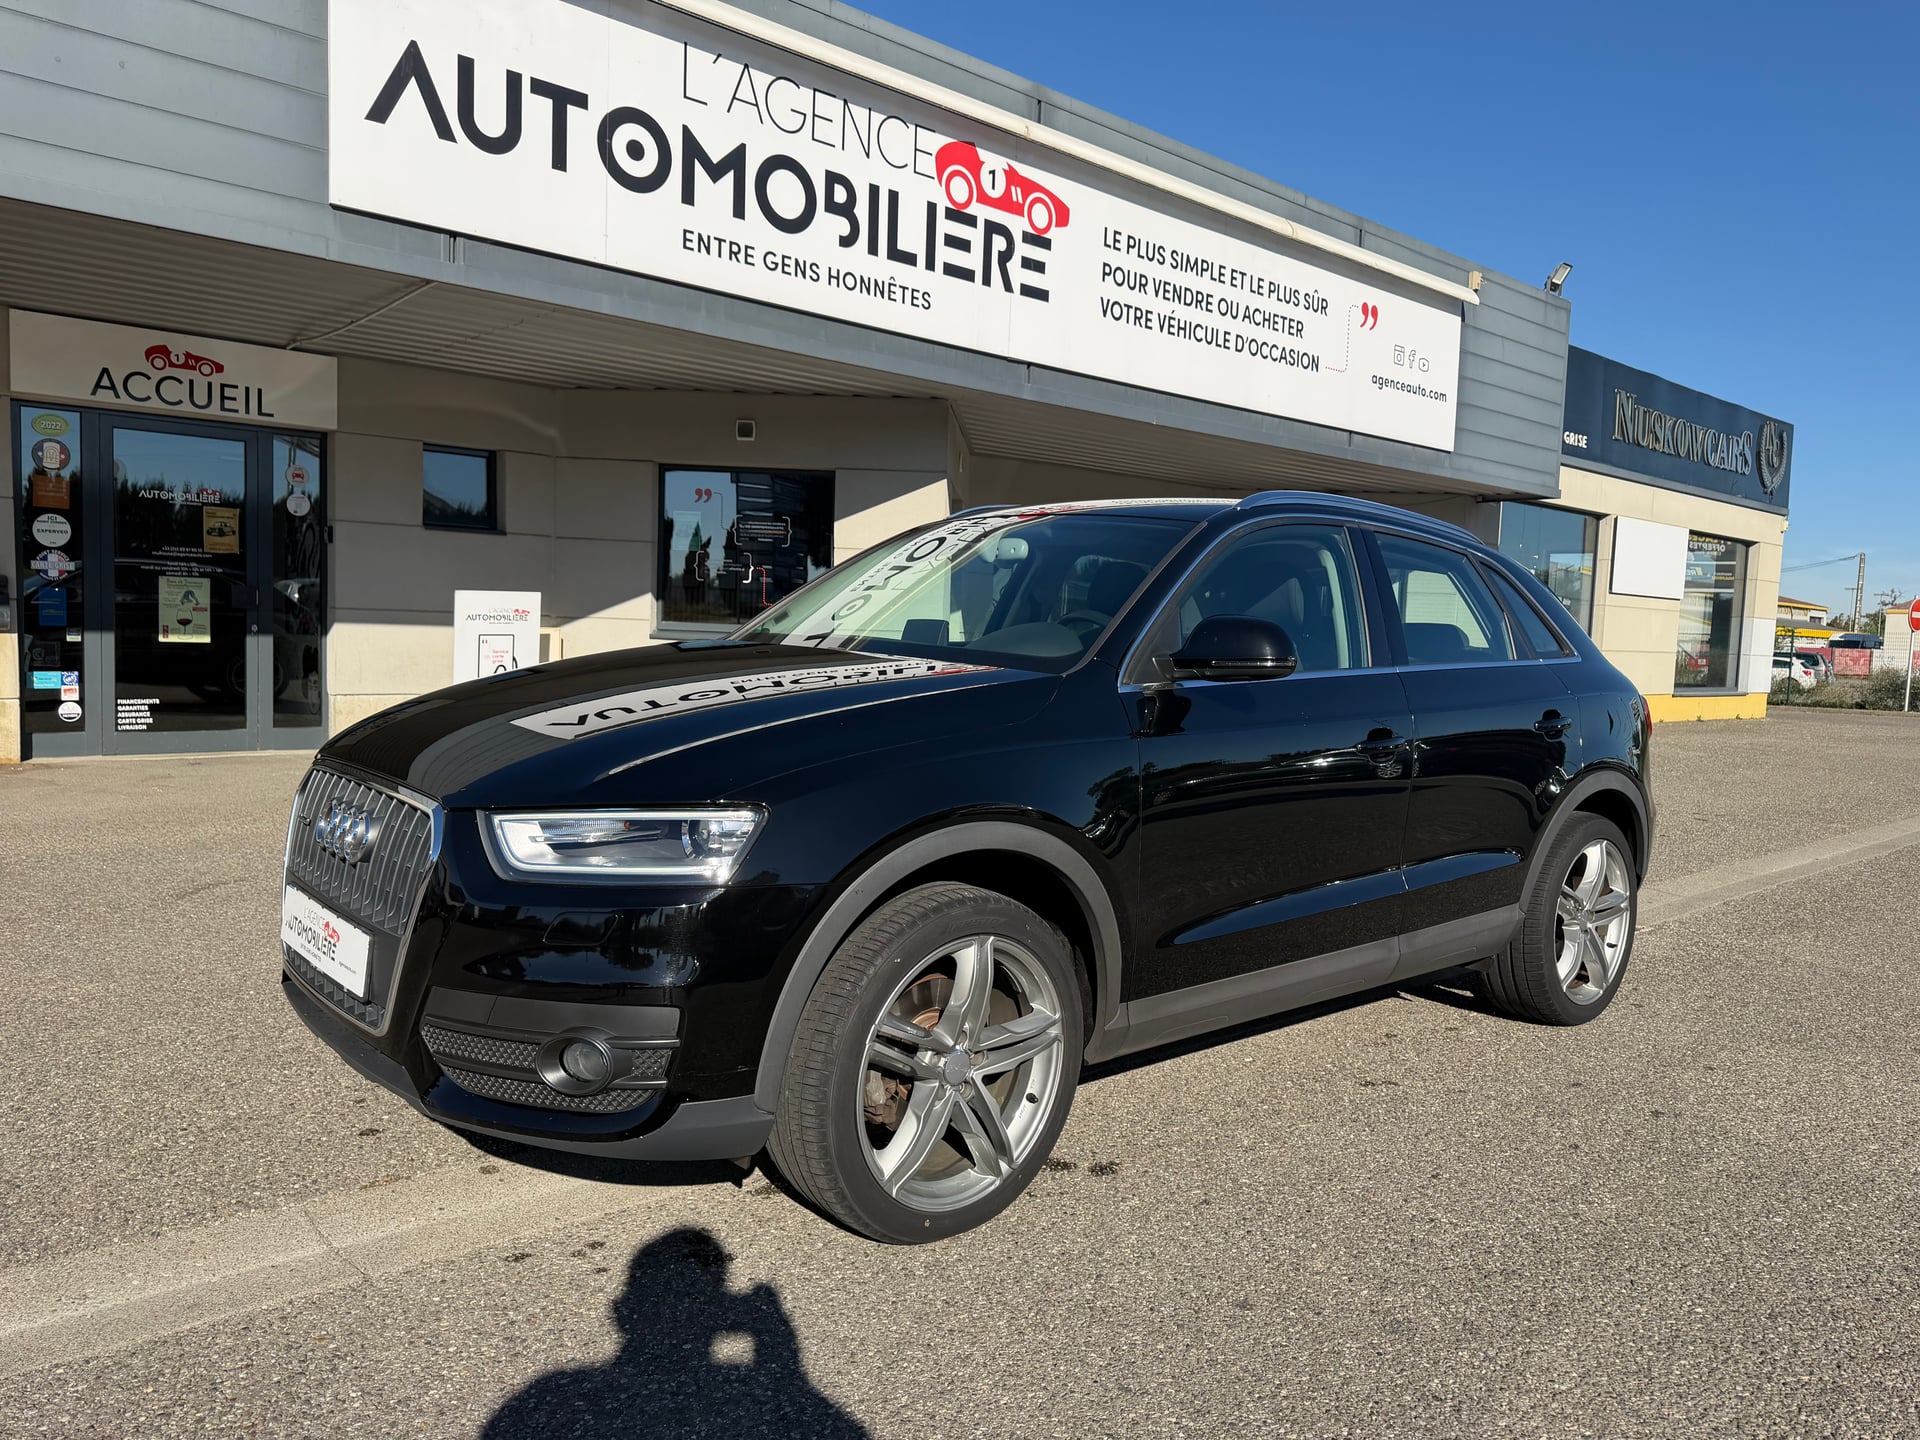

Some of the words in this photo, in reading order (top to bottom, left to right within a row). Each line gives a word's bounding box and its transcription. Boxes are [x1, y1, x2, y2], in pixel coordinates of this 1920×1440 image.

[987, 168, 997, 191] 1
[682, 228, 756, 267] ENTRE
[763, 251, 821, 283] GENS
[828, 266, 932, 310] HONNÊTES
[1101, 261, 1149, 295] POUR
[1152, 277, 1214, 314] VENDRE
[1217, 297, 1240, 320] OU
[1242, 305, 1304, 339] ACHETER
[1103, 226, 1122, 252] LE
[1126, 234, 1166, 266] PLUS
[1170, 249, 1226, 284] SIMPLE
[1230, 268, 1247, 291] ET
[1249, 274, 1265, 297] LE
[1268, 281, 1300, 308] PLUS
[1303, 289, 1329, 317] SÛR
[1100, 296, 1153, 331] VOTRE
[1157, 310, 1231, 350] VÉHICULE
[1234, 334, 1320, 373] D'OCCASION
[90, 366, 275, 418] ACCUEIL
[1371, 373, 1448, 403] agenceauto.com
[1563, 431, 1588, 449] GRISE
